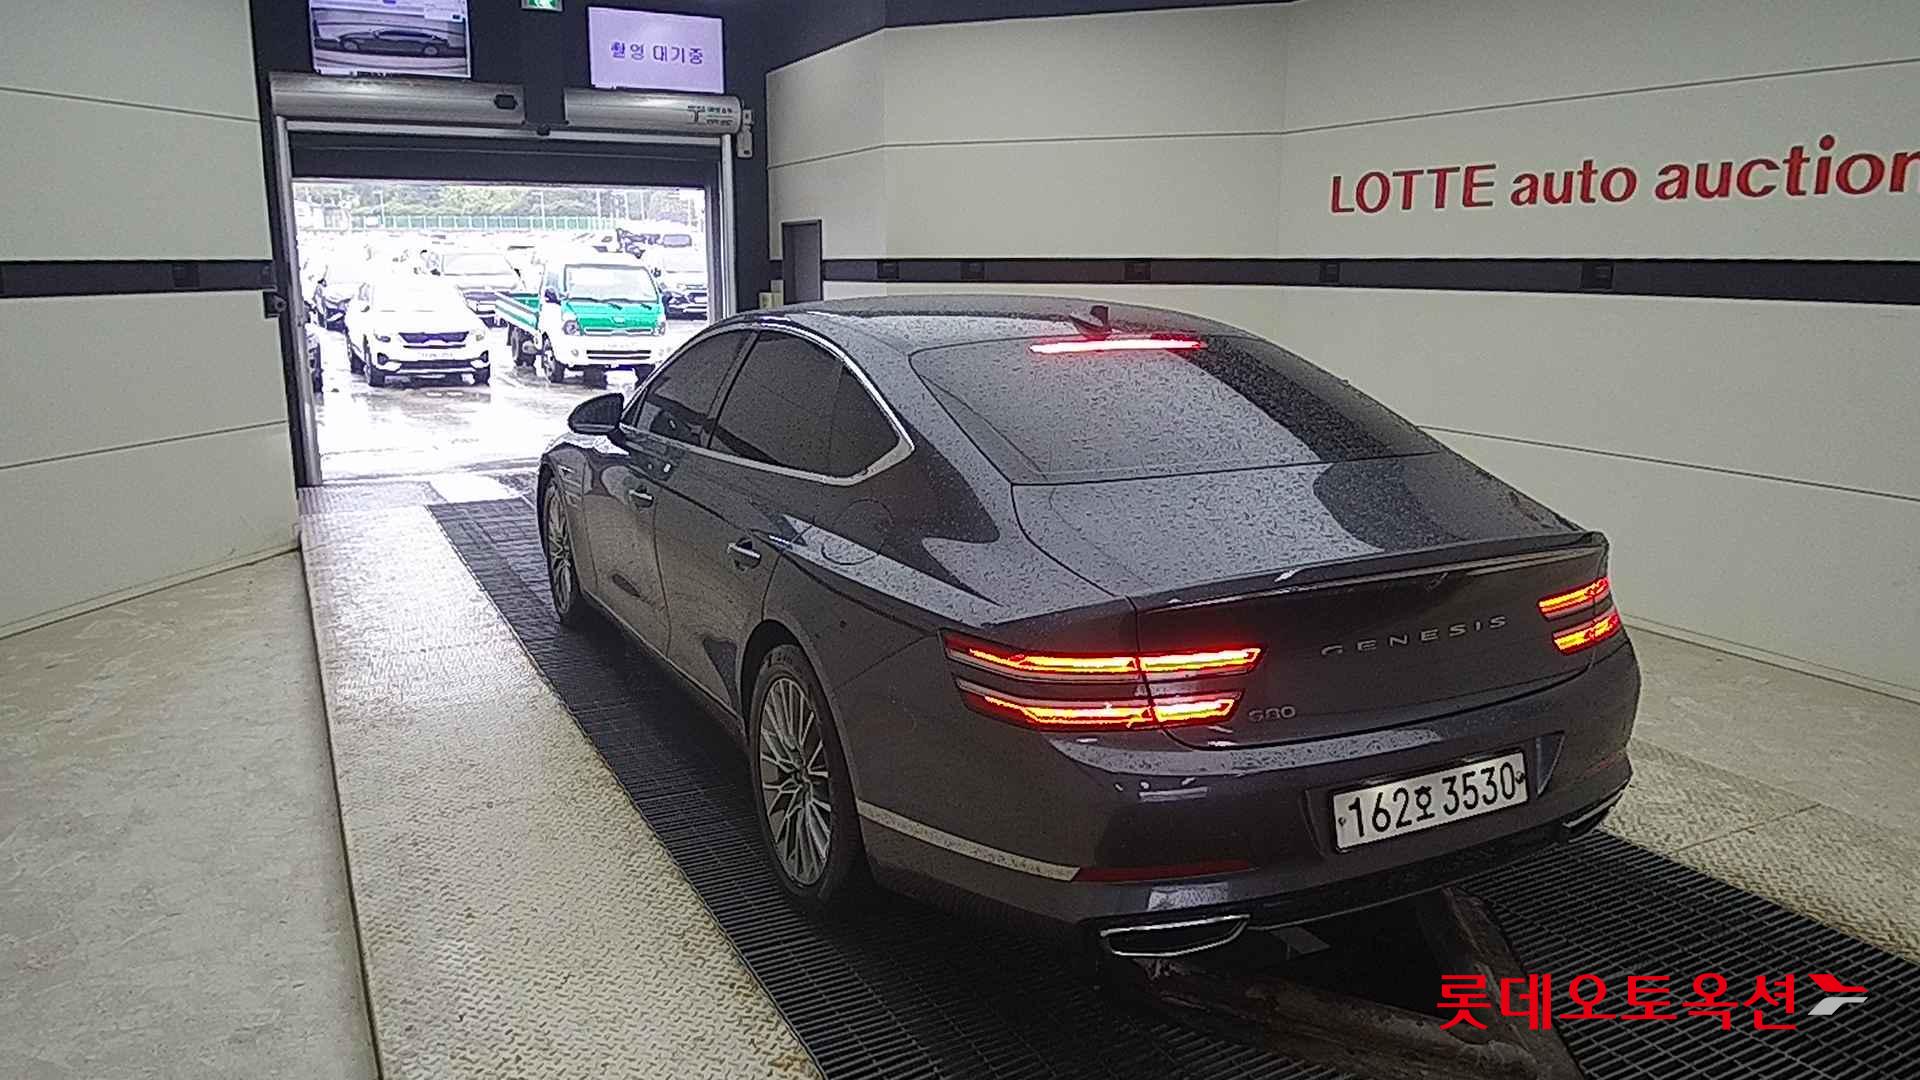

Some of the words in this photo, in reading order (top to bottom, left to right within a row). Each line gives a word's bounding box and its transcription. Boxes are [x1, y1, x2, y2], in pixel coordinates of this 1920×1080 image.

[653, 45, 703, 64] 대기중
[1331, 164, 1496, 213] LOTTE
[1511, 160, 1637, 206] auto
[1321, 615, 1507, 655] GENESIS
[1348, 786, 1435, 837] 162호
[1442, 762, 1515, 815] 3530
